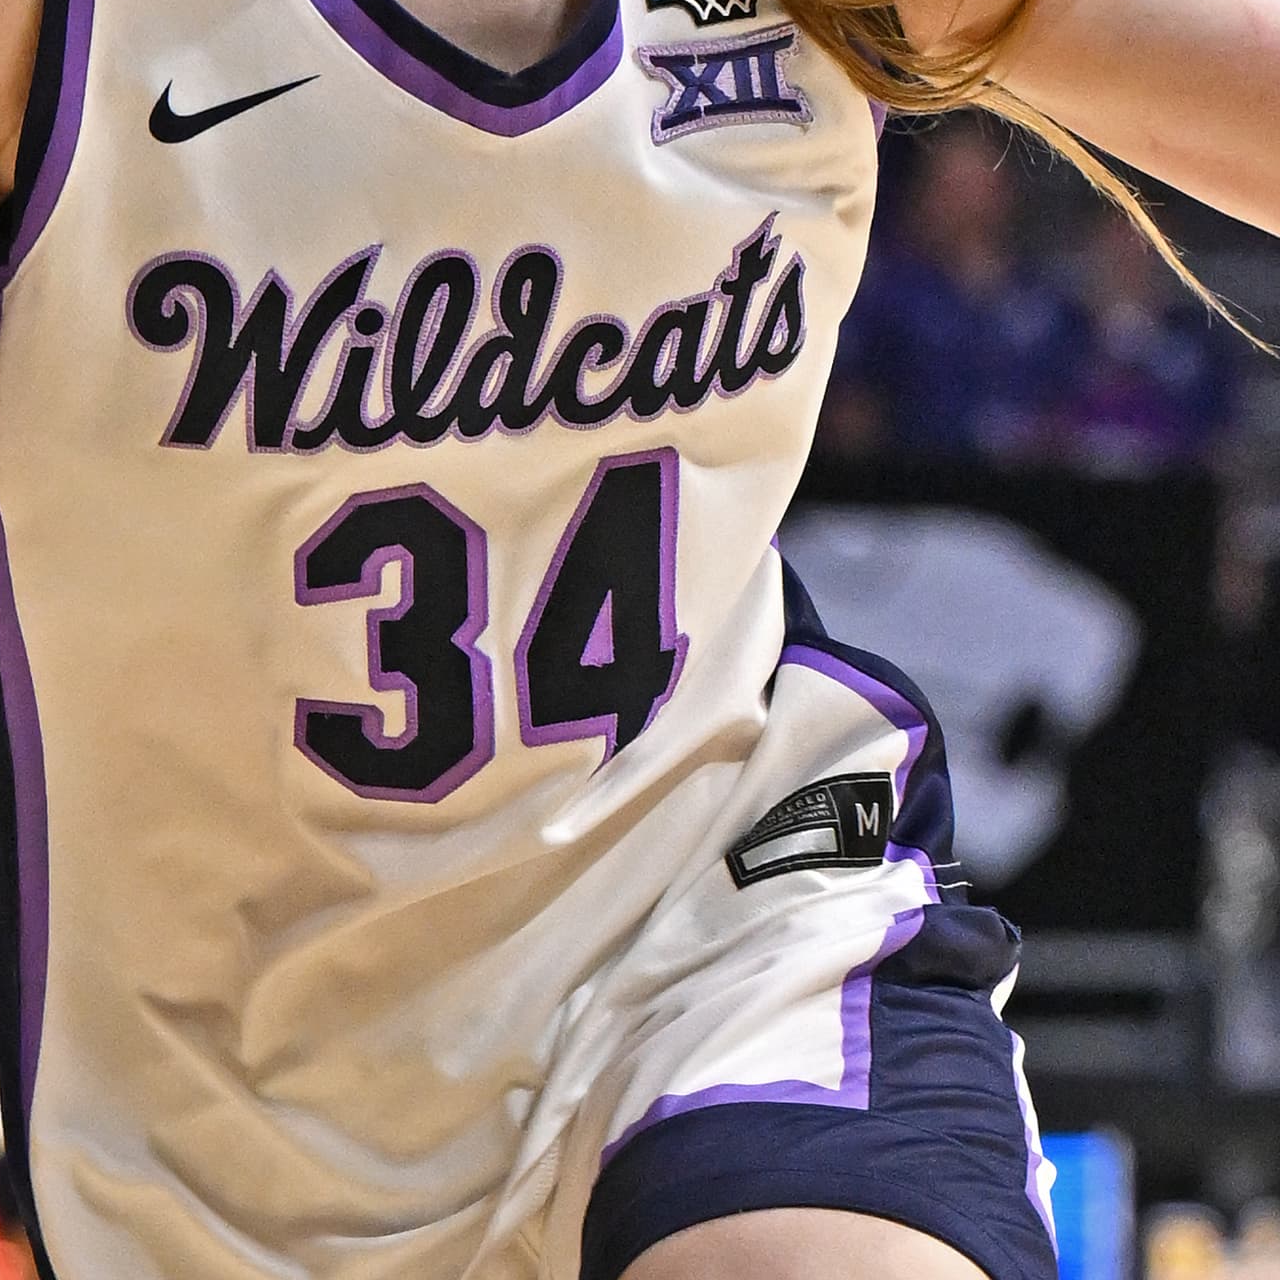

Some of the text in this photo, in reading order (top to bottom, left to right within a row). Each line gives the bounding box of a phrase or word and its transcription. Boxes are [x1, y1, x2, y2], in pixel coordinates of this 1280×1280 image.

[645, 29, 806, 135] XII
[126, 211, 807, 455] Wildcats
[294, 446, 689, 803] 34
[855, 802, 879, 837] M
